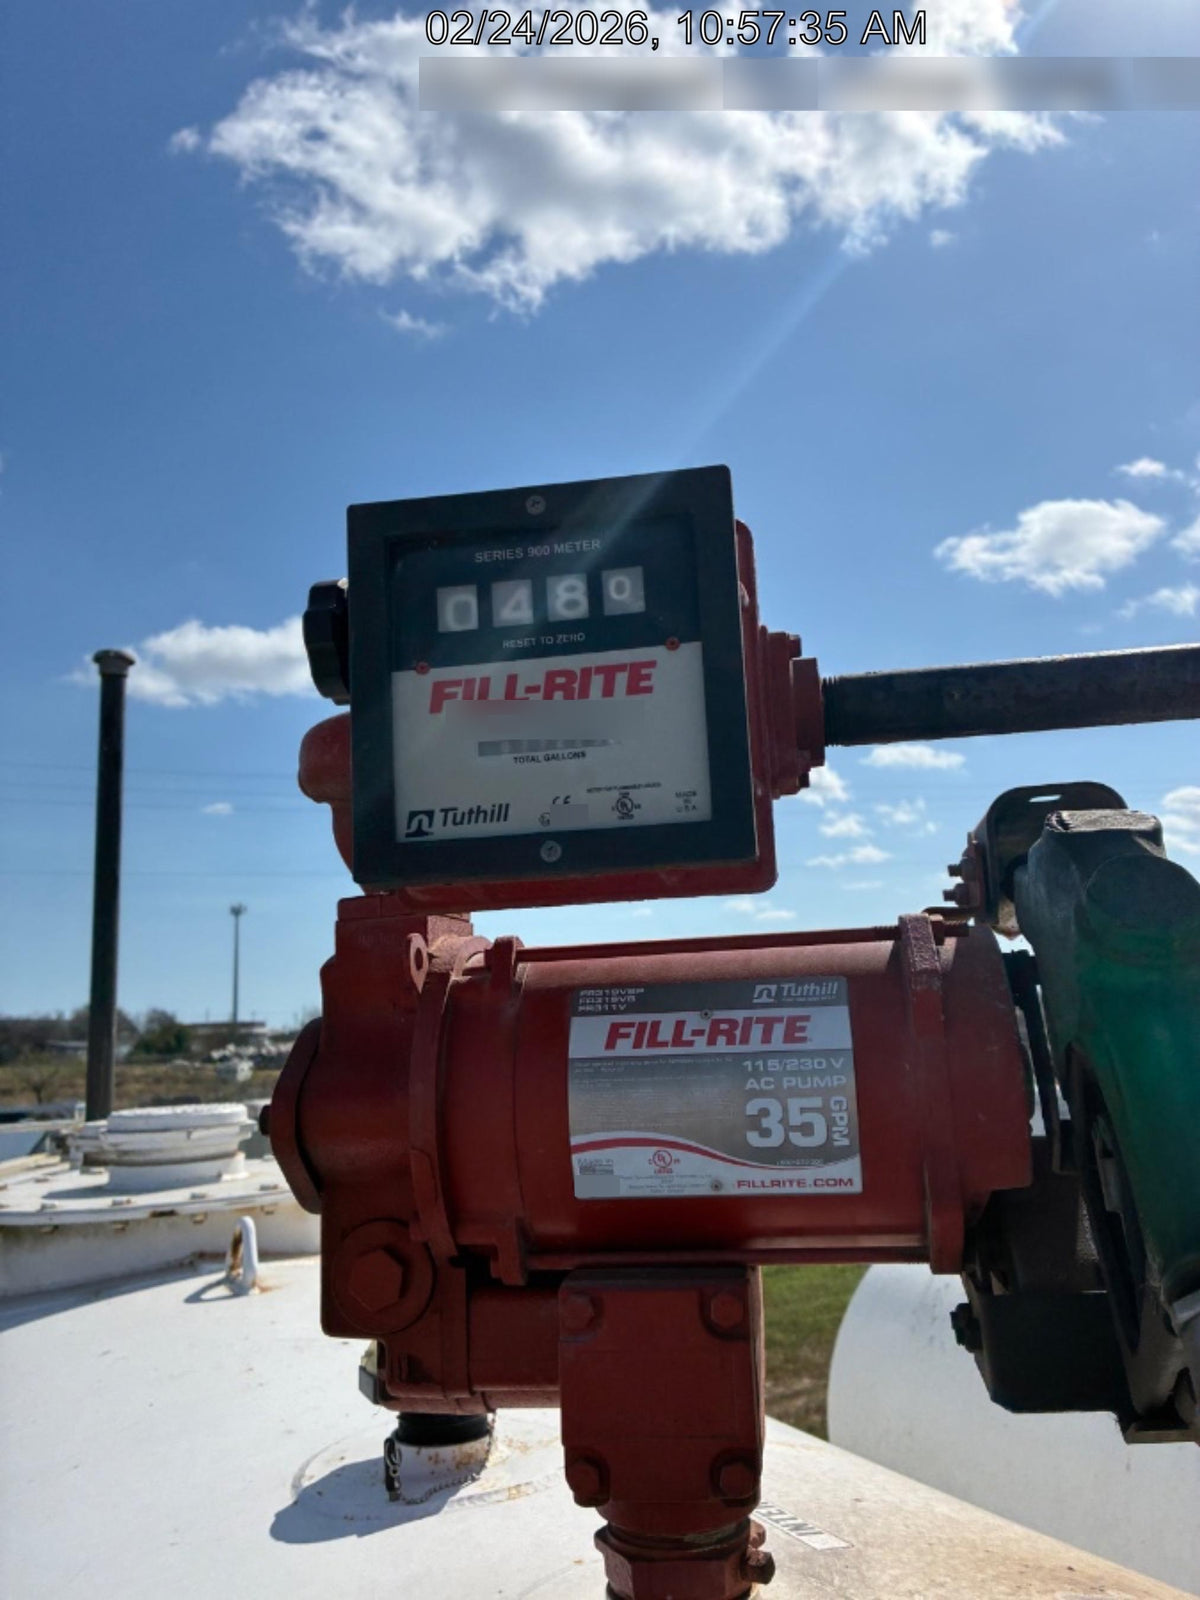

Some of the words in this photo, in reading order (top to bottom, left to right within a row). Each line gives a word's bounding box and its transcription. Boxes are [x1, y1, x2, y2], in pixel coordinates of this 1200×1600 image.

[474, 547, 524, 563] SERIES
[528, 545, 550, 557] 900
[554, 538, 601, 554] METER
[503, 638, 536, 649] RESET
[540, 635, 554, 645] TO
[556, 632, 586, 644] ZERO
[429, 660, 656, 715] FILL-RITE
[513, 754, 542, 765] TOTAL
[544, 750, 587, 762] GALLONS
[438, 803, 511, 829] Tuthill
[780, 982, 839, 997] Tuthill
[604, 1015, 811, 1051] FILL-RITE
[743, 1058, 826, 1073] 115/230
[830, 1057, 845, 1070] V
[744, 1077, 775, 1090] AC
[783, 1075, 848, 1089] PUMP
[746, 1096, 829, 1149] 35
[829, 1095, 850, 1147] GPM
[736, 1178, 854, 1190] FILLRITE.COM
